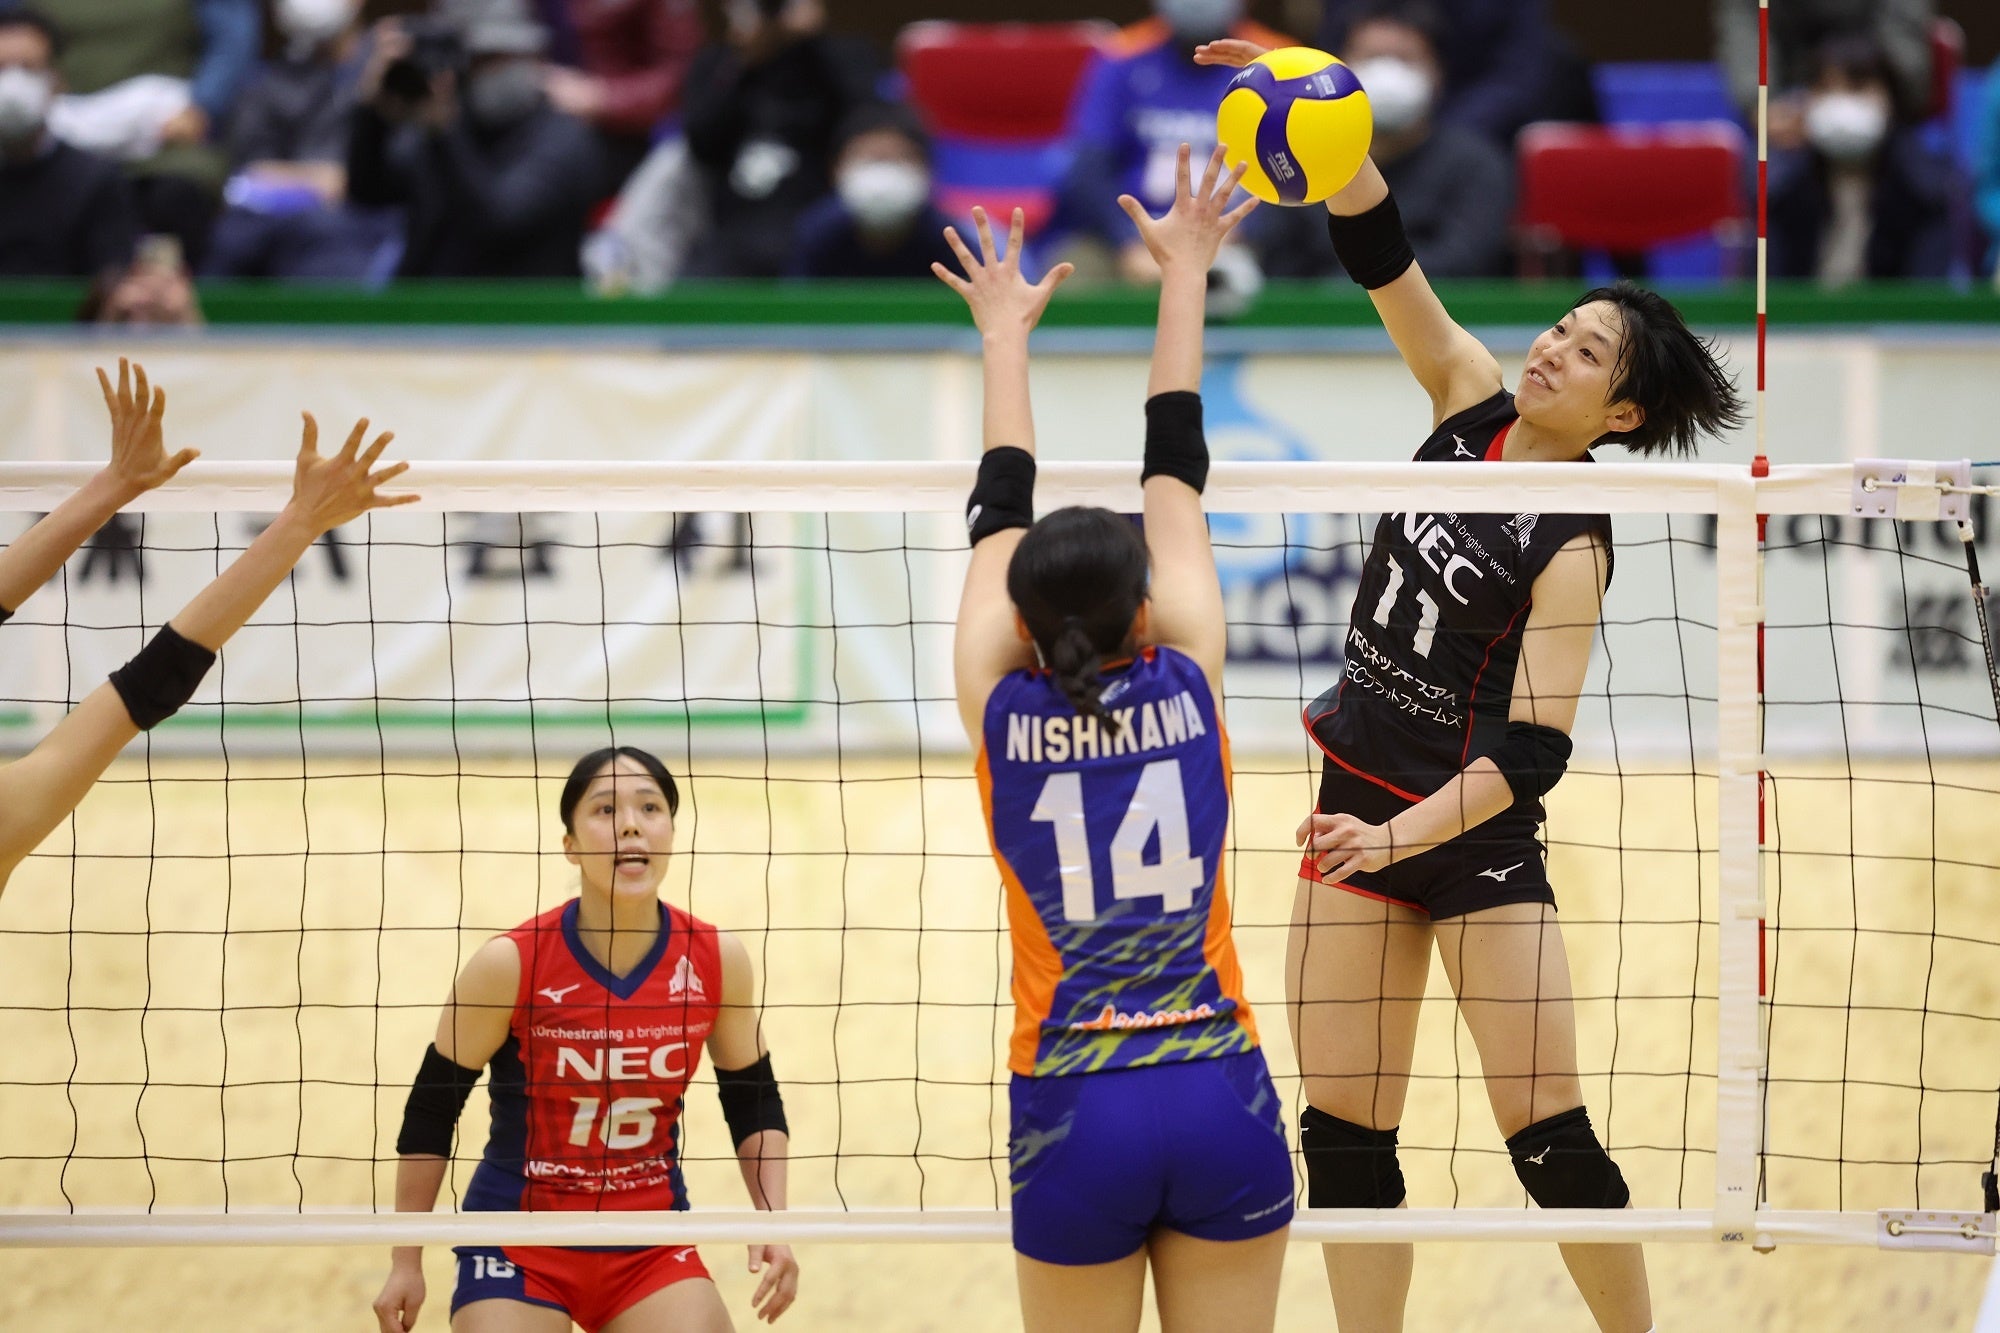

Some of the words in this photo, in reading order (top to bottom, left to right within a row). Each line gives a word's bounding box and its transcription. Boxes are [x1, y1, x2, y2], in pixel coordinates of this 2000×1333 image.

[1391, 513, 1484, 606] NEC
[1457, 524, 1490, 561] brighter
[1372, 553, 1440, 661] 11
[1006, 690, 1206, 764] NISHIKAWA
[1030, 759, 1205, 922] 14
[626, 1030, 635, 1039] a
[637, 1024, 684, 1040] brighter
[556, 1042, 690, 1081] NEC
[568, 1096, 664, 1150] 16
[472, 1254, 515, 1280] 16
